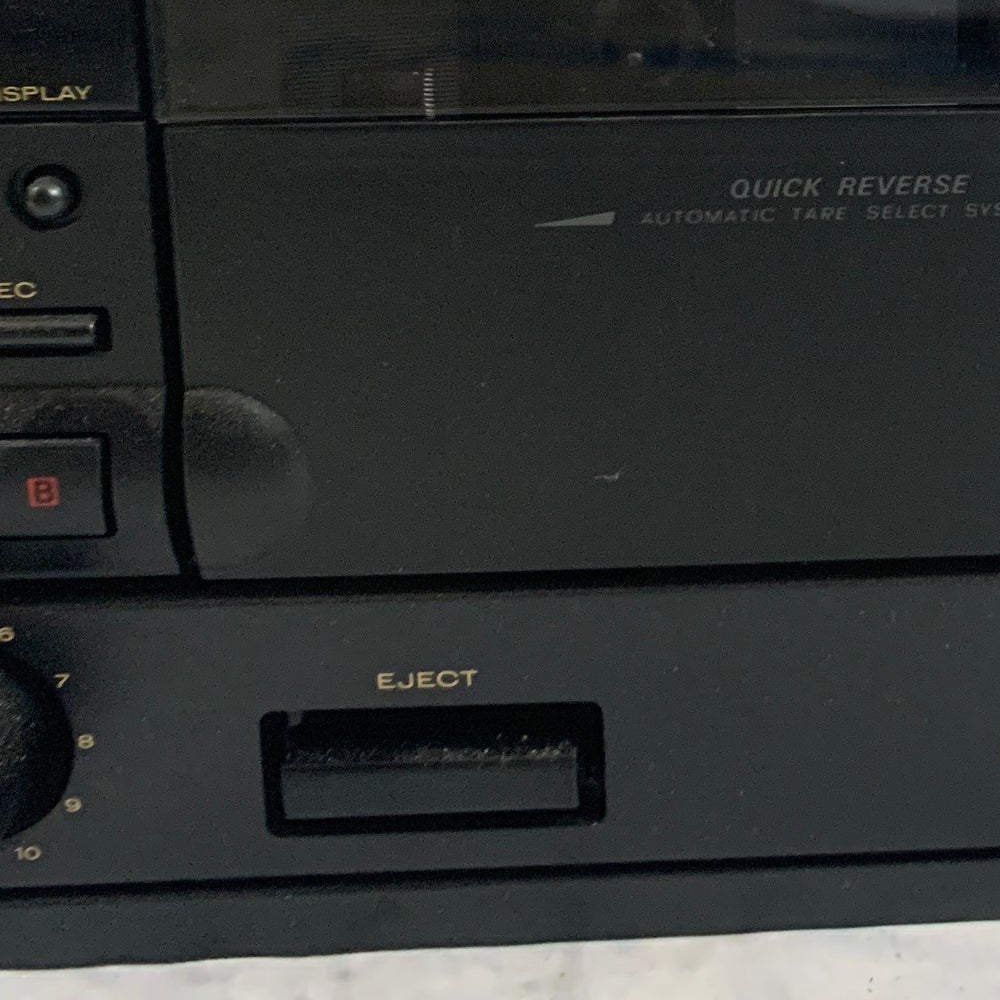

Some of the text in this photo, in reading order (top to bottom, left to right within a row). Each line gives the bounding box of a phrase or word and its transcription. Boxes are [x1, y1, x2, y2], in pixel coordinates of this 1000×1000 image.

[730, 174, 971, 199] QUICK REVERSE
[639, 207, 777, 225] AUTOMATIC
[866, 203, 949, 220] SELECT
[31, 479, 57, 505] B
[54, 673, 70, 688] 7
[376, 669, 478, 689] EJECT
[78, 734, 95, 749] 8
[64, 798, 82, 813] 9
[14, 846, 42, 861] 10
